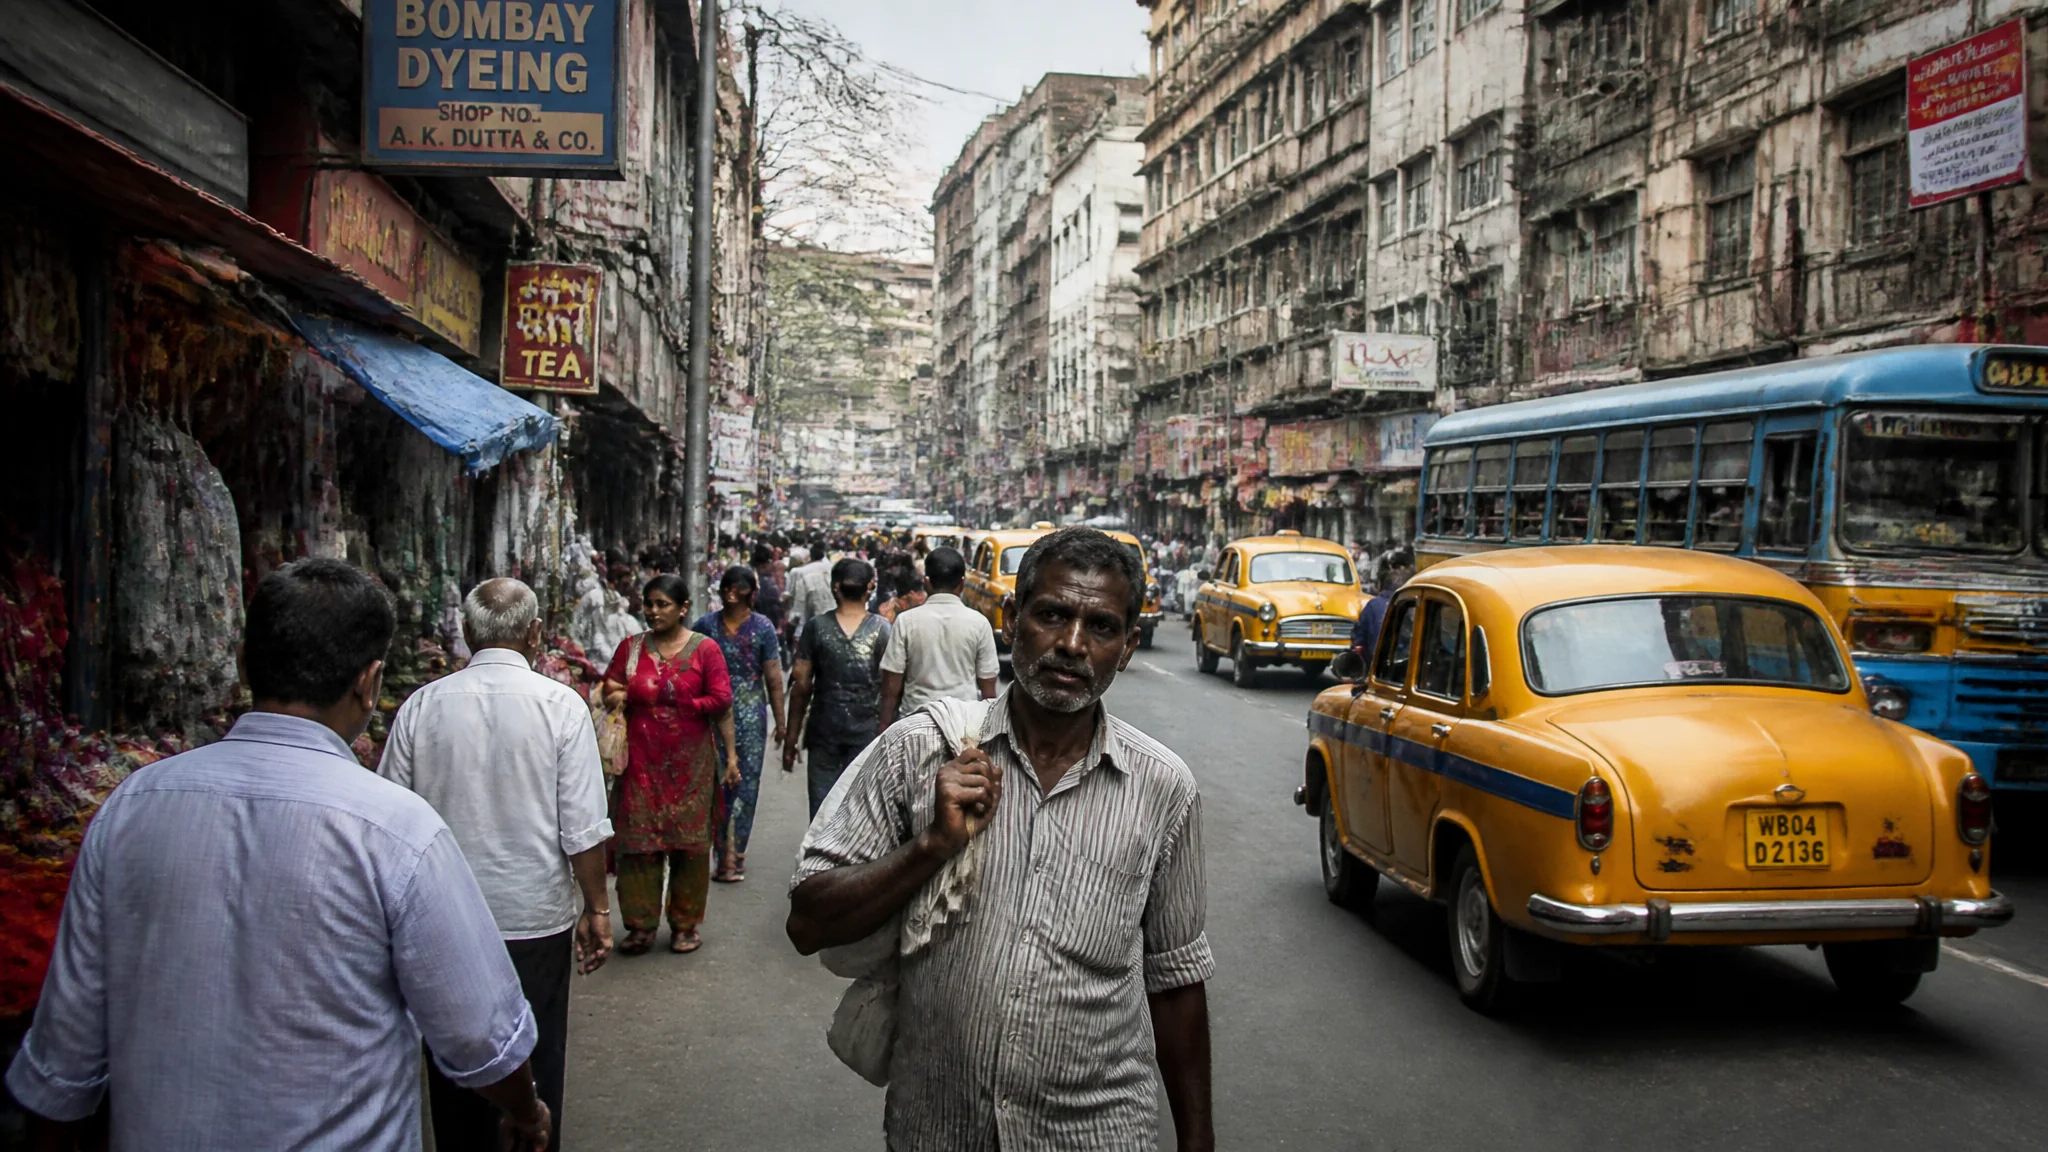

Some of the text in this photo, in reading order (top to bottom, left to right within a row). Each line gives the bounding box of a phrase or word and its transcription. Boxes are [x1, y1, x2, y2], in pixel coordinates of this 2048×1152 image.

[396, 0, 594, 43] BOMBAY
[398, 48, 588, 93] DYEING
[439, 104, 493, 122] SHOP
[390, 127, 595, 151] A. K. DUTTA & CO.
[521, 350, 581, 378] TEA
[1758, 814, 1816, 836] WB04
